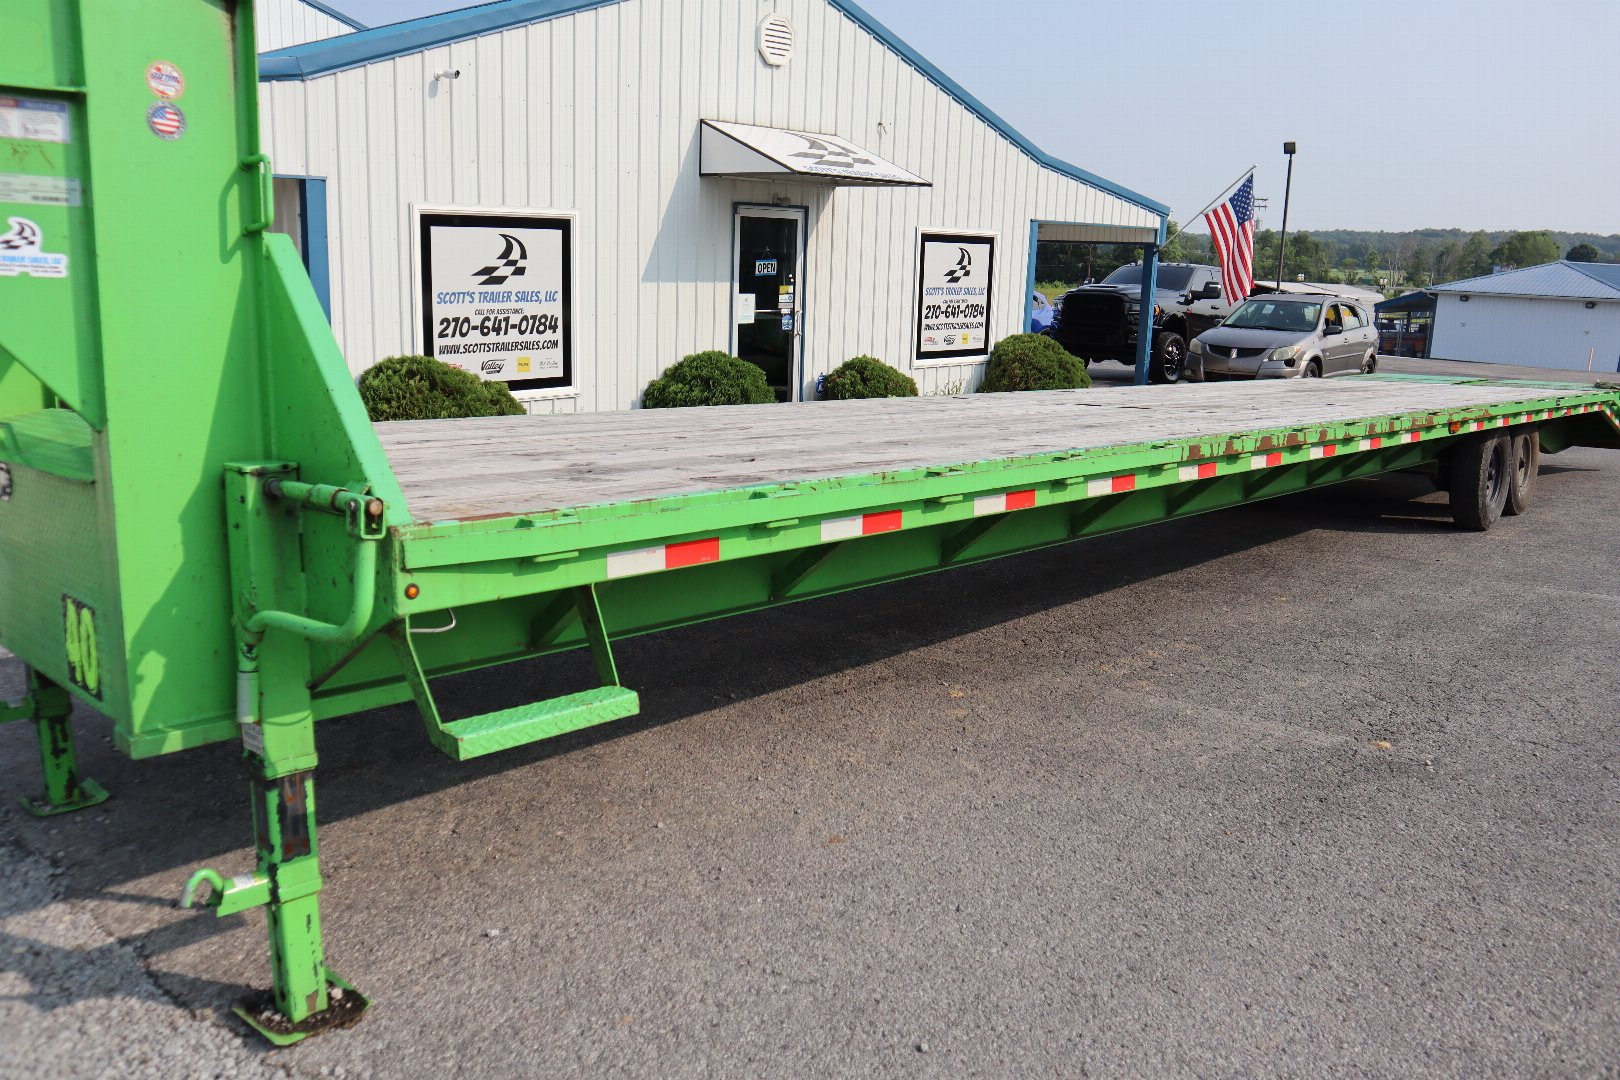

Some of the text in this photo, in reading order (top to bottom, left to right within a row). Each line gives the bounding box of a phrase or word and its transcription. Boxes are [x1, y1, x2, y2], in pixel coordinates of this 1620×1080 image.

[757, 262, 776, 273] OPEN
[436, 290, 559, 304] SCOTT'S TRAILER SALES, LLC
[925, 287, 945, 296] SCOTT'S
[924, 304, 984, 319] 270-641-0784
[437, 314, 559, 338] 270-641-0784
[438, 339, 559, 356] WWW.SCOTTSTRAILERSALES.COM
[481, 358, 506, 373] Valley
[65, 598, 98, 695] 40
